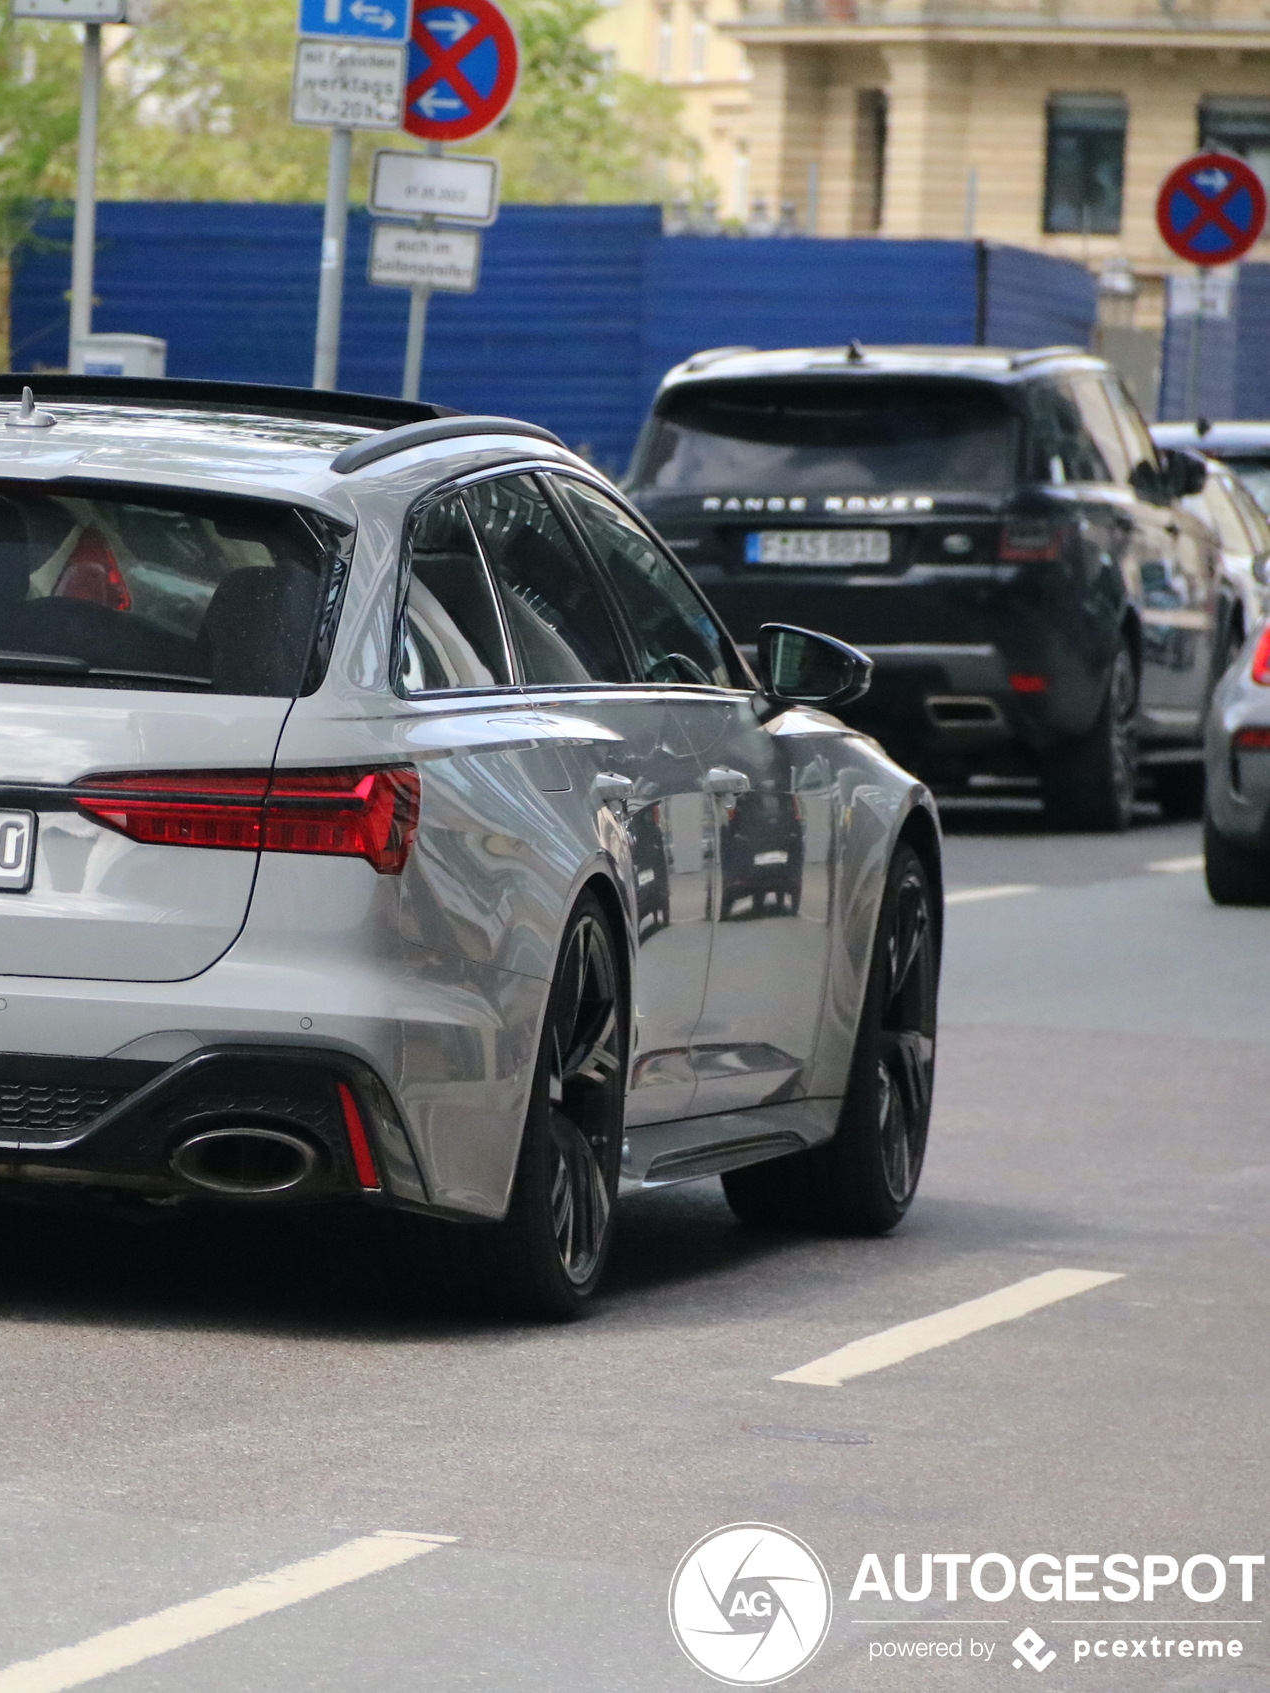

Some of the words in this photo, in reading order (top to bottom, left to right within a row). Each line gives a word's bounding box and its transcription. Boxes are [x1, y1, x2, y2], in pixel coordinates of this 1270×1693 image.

[302, 76, 394, 98] werktags
[394, 240, 428, 254] auch
[703, 496, 807, 512] RANGE
[824, 495, 934, 511] ROVER
